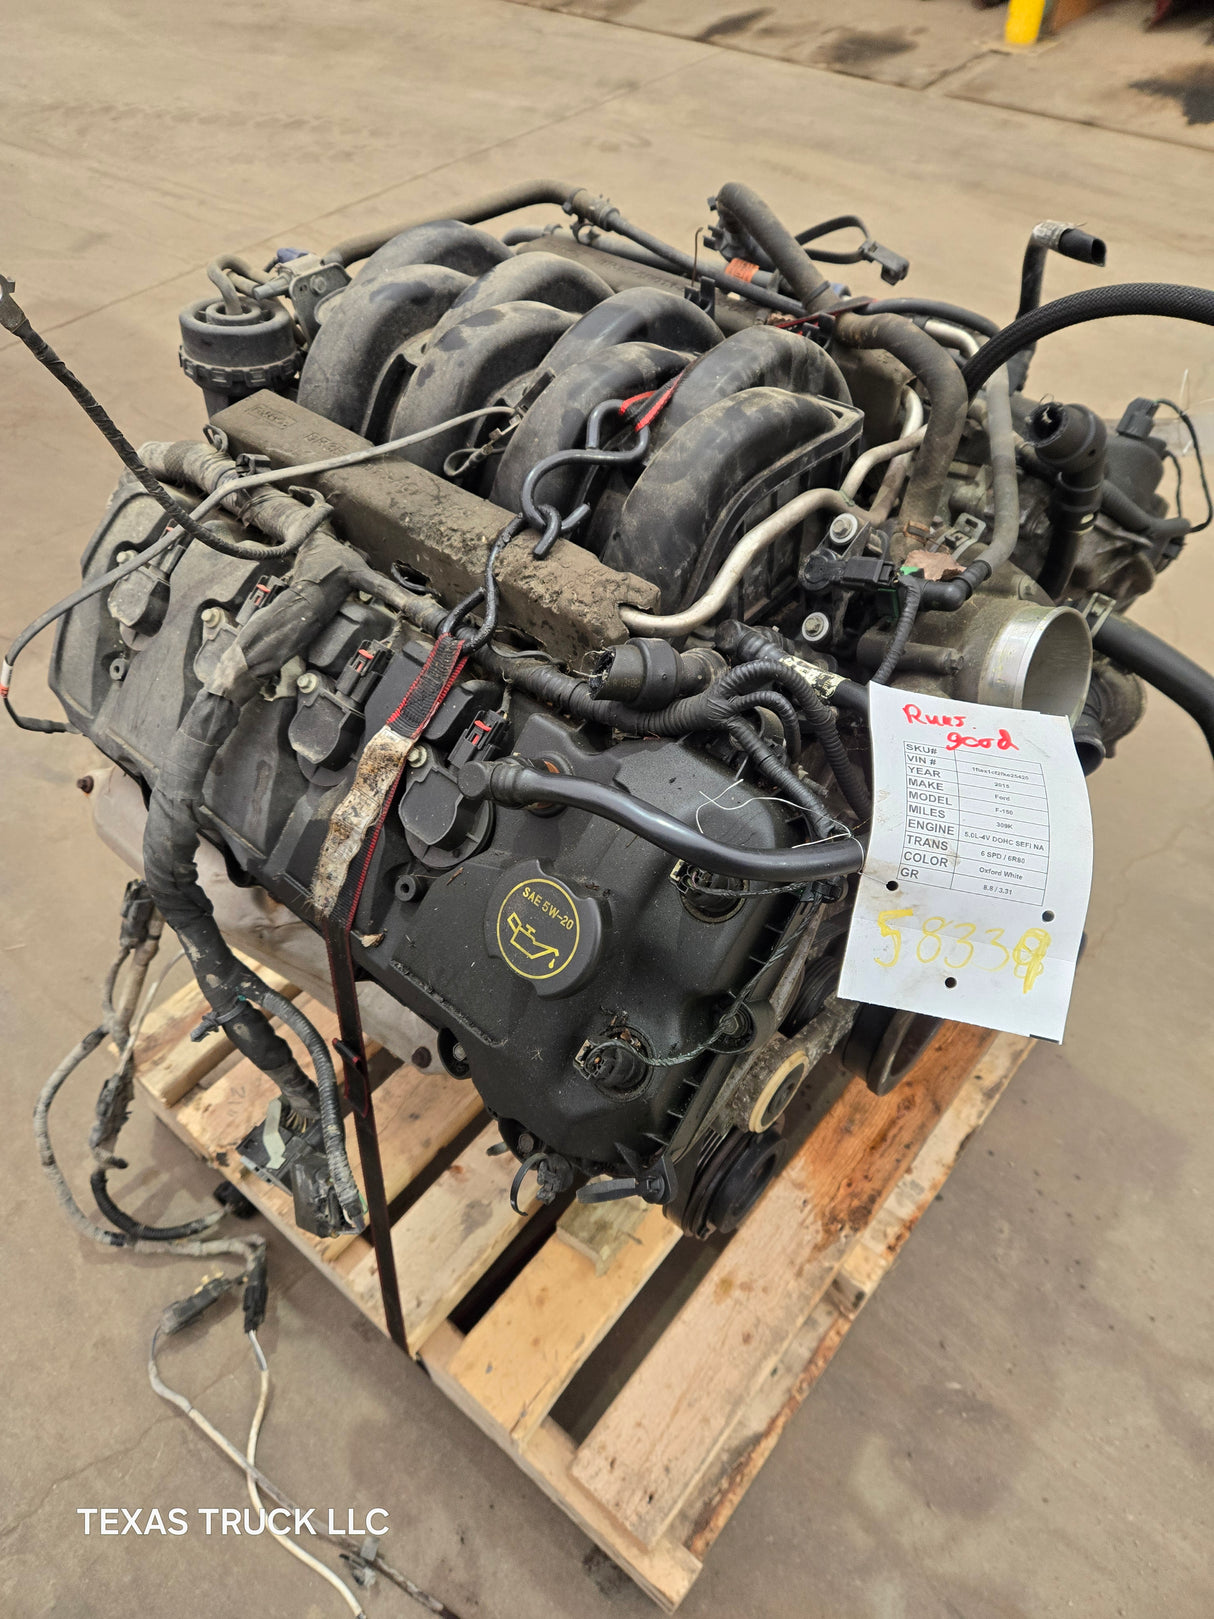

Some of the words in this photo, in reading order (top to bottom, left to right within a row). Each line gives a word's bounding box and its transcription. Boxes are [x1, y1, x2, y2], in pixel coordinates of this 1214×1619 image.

[905, 743, 938, 755] SKU#
[945, 728, 1020, 751] good
[906, 754, 927, 764] VIN
[929, 757, 937, 766] #
[907, 765, 942, 778] YEAR
[908, 778, 945, 791] MAKE
[994, 793, 1011, 802] Ford
[908, 791, 953, 806] MODEL
[995, 807, 1014, 816] F-150
[908, 804, 946, 819] MILES
[908, 818, 955, 836] ENGINE
[992, 835, 1014, 846] DOHC
[1015, 840, 1032, 849] SEFI
[1033, 843, 1045, 852] NA
[906, 834, 949, 851] TRANS
[986, 851, 1002, 861] SPD
[1007, 855, 1026, 864] 6R80
[903, 851, 949, 868] COLOR
[979, 866, 1003, 877] Oxford
[1004, 870, 1024, 881] White
[900, 867, 919, 880] GR
[983, 884, 994, 892] 8.8
[998, 887, 1013, 896] 3.31
[522, 886, 543, 907] SAE
[541, 900, 574, 931] 5W-20
